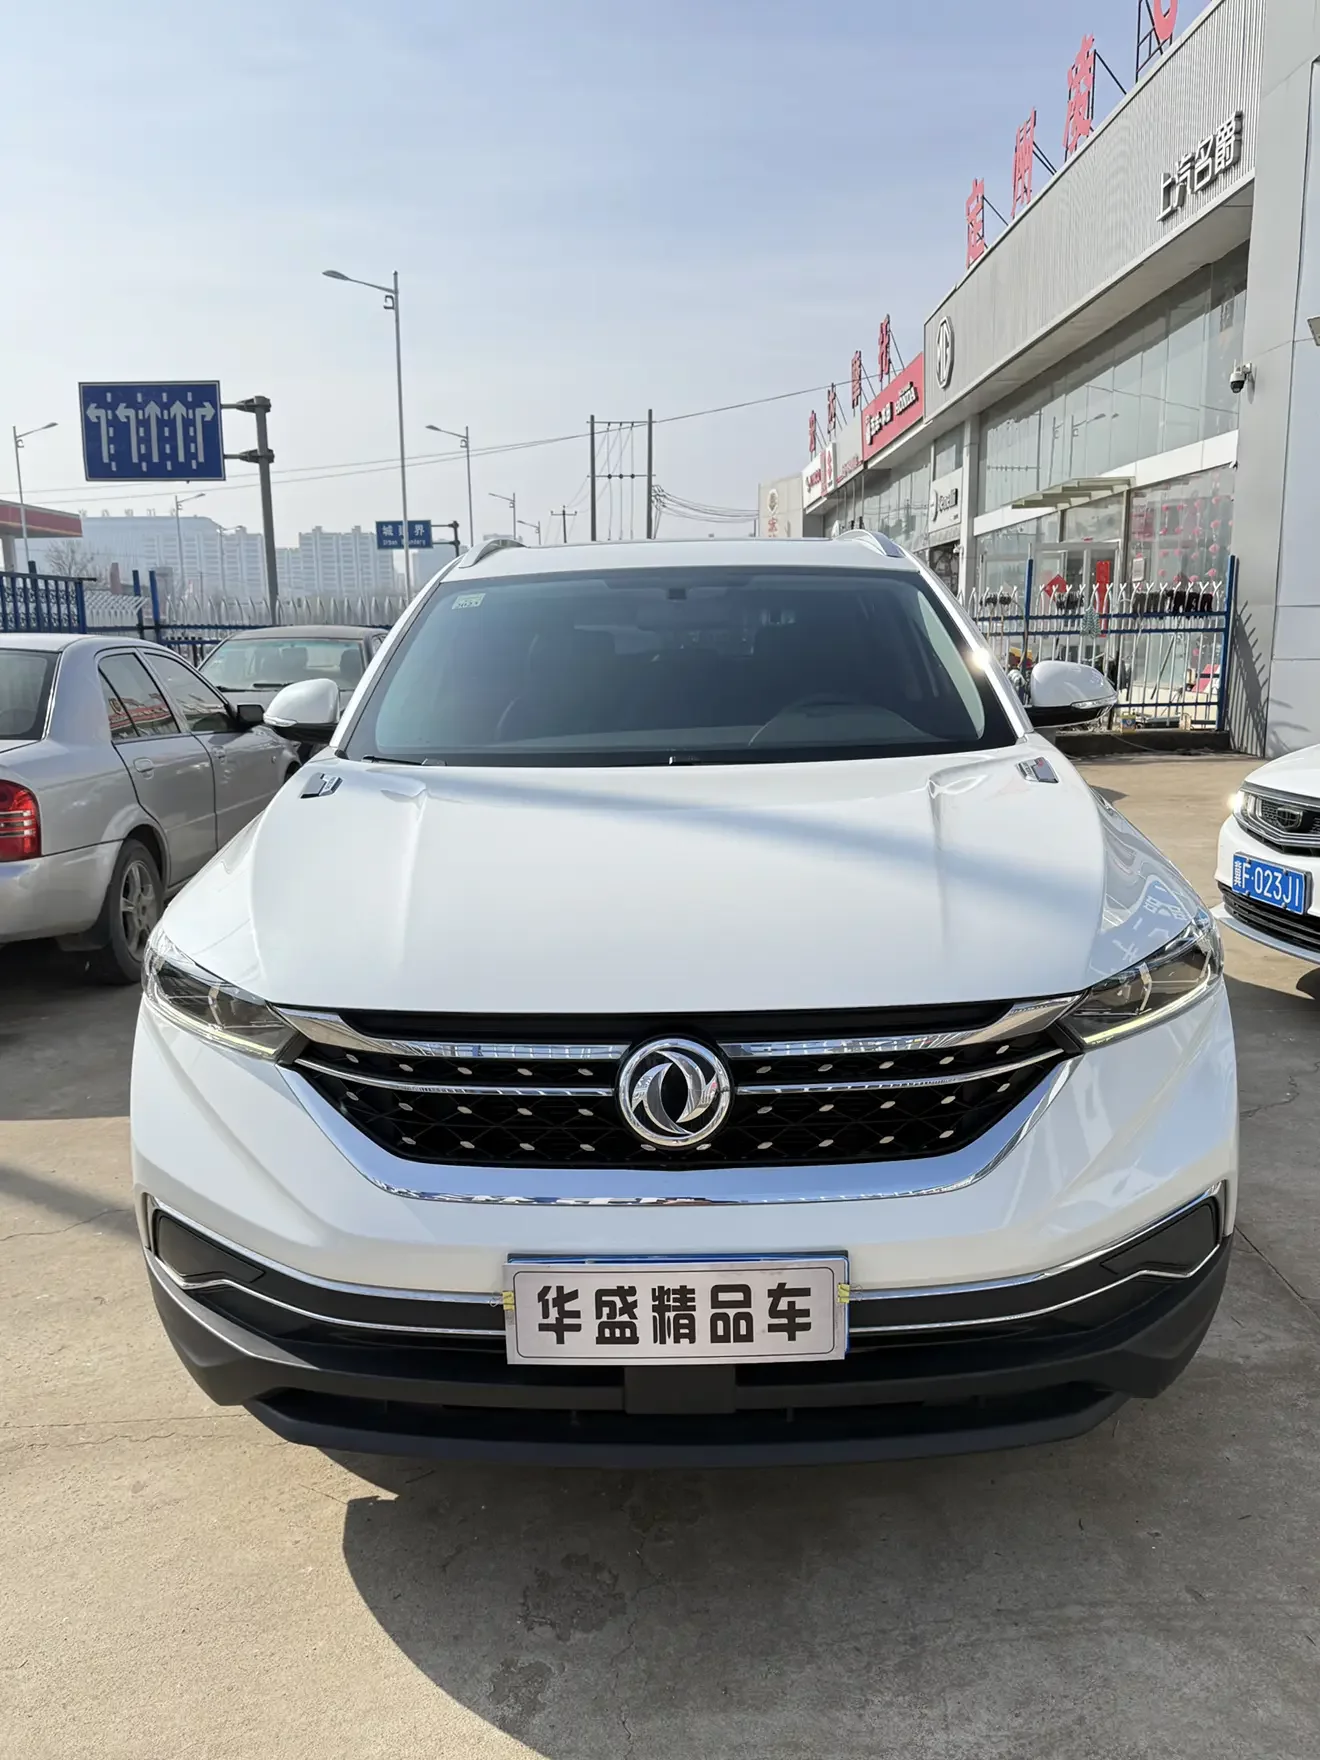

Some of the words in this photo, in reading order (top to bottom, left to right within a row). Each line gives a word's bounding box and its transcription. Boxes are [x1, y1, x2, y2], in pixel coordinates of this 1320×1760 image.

[1156, 110, 1243, 222] 上汽名爵
[537, 1282, 812, 1345] 华盛精品车
